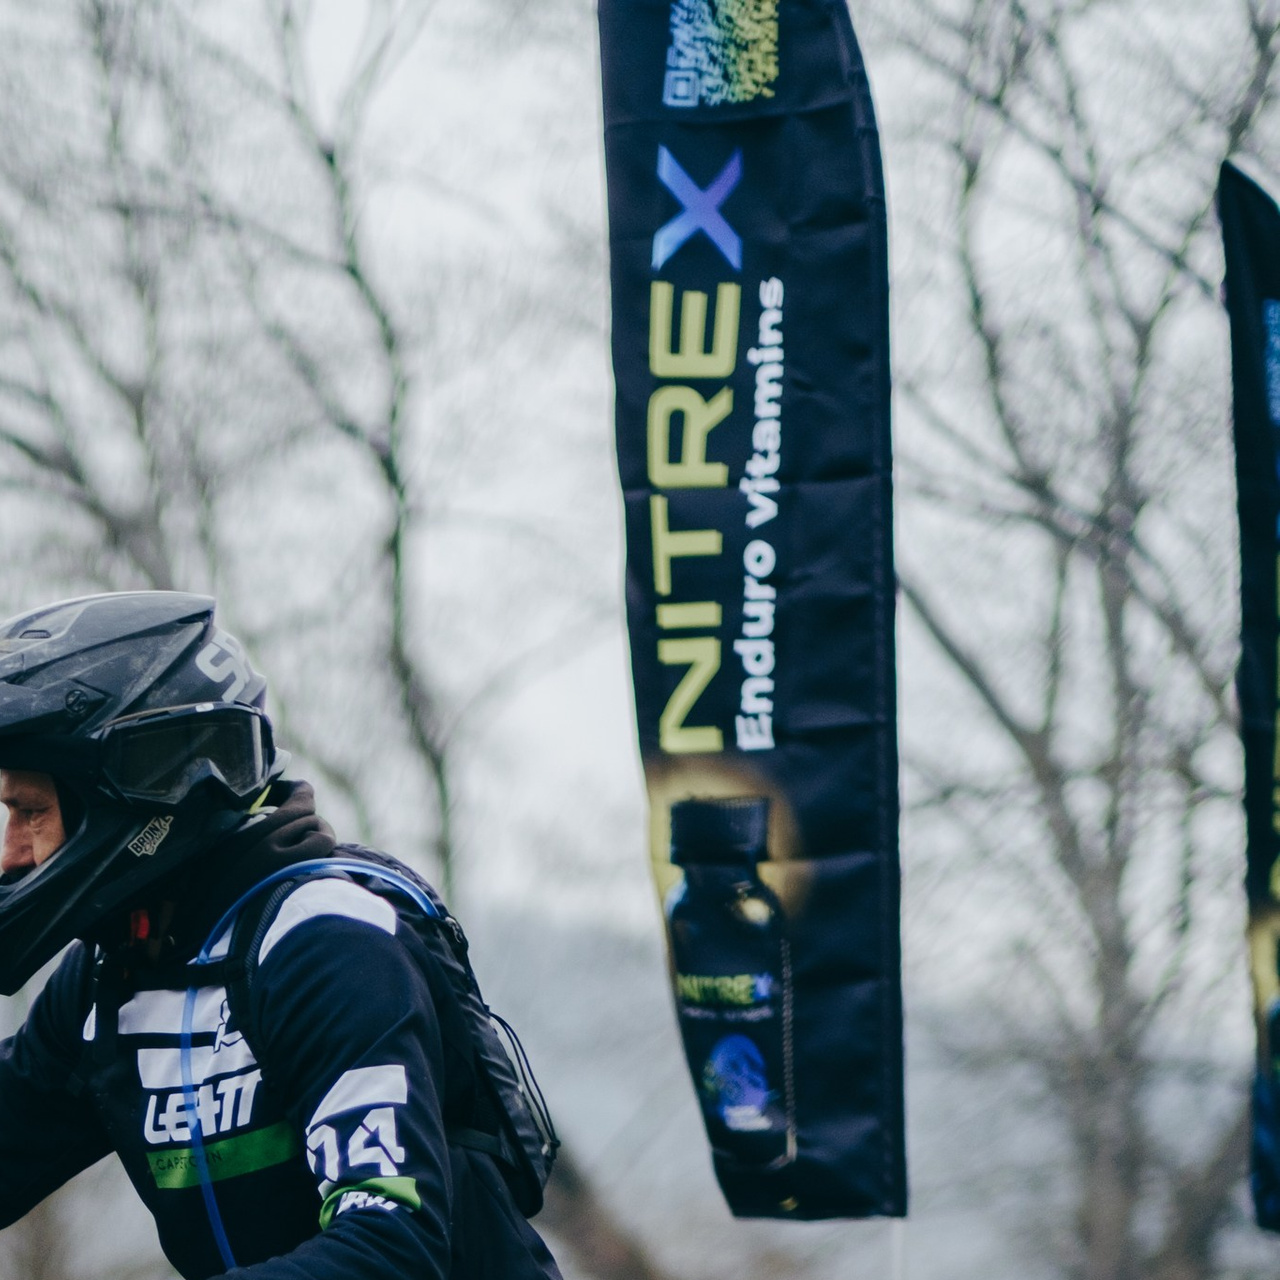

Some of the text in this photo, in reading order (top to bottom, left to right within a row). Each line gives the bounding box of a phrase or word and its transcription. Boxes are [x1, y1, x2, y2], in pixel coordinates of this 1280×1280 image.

[647, 144, 742, 752] NITREX
[734, 539, 777, 752] Enduro
[144, 1068, 263, 1145] LEATT
